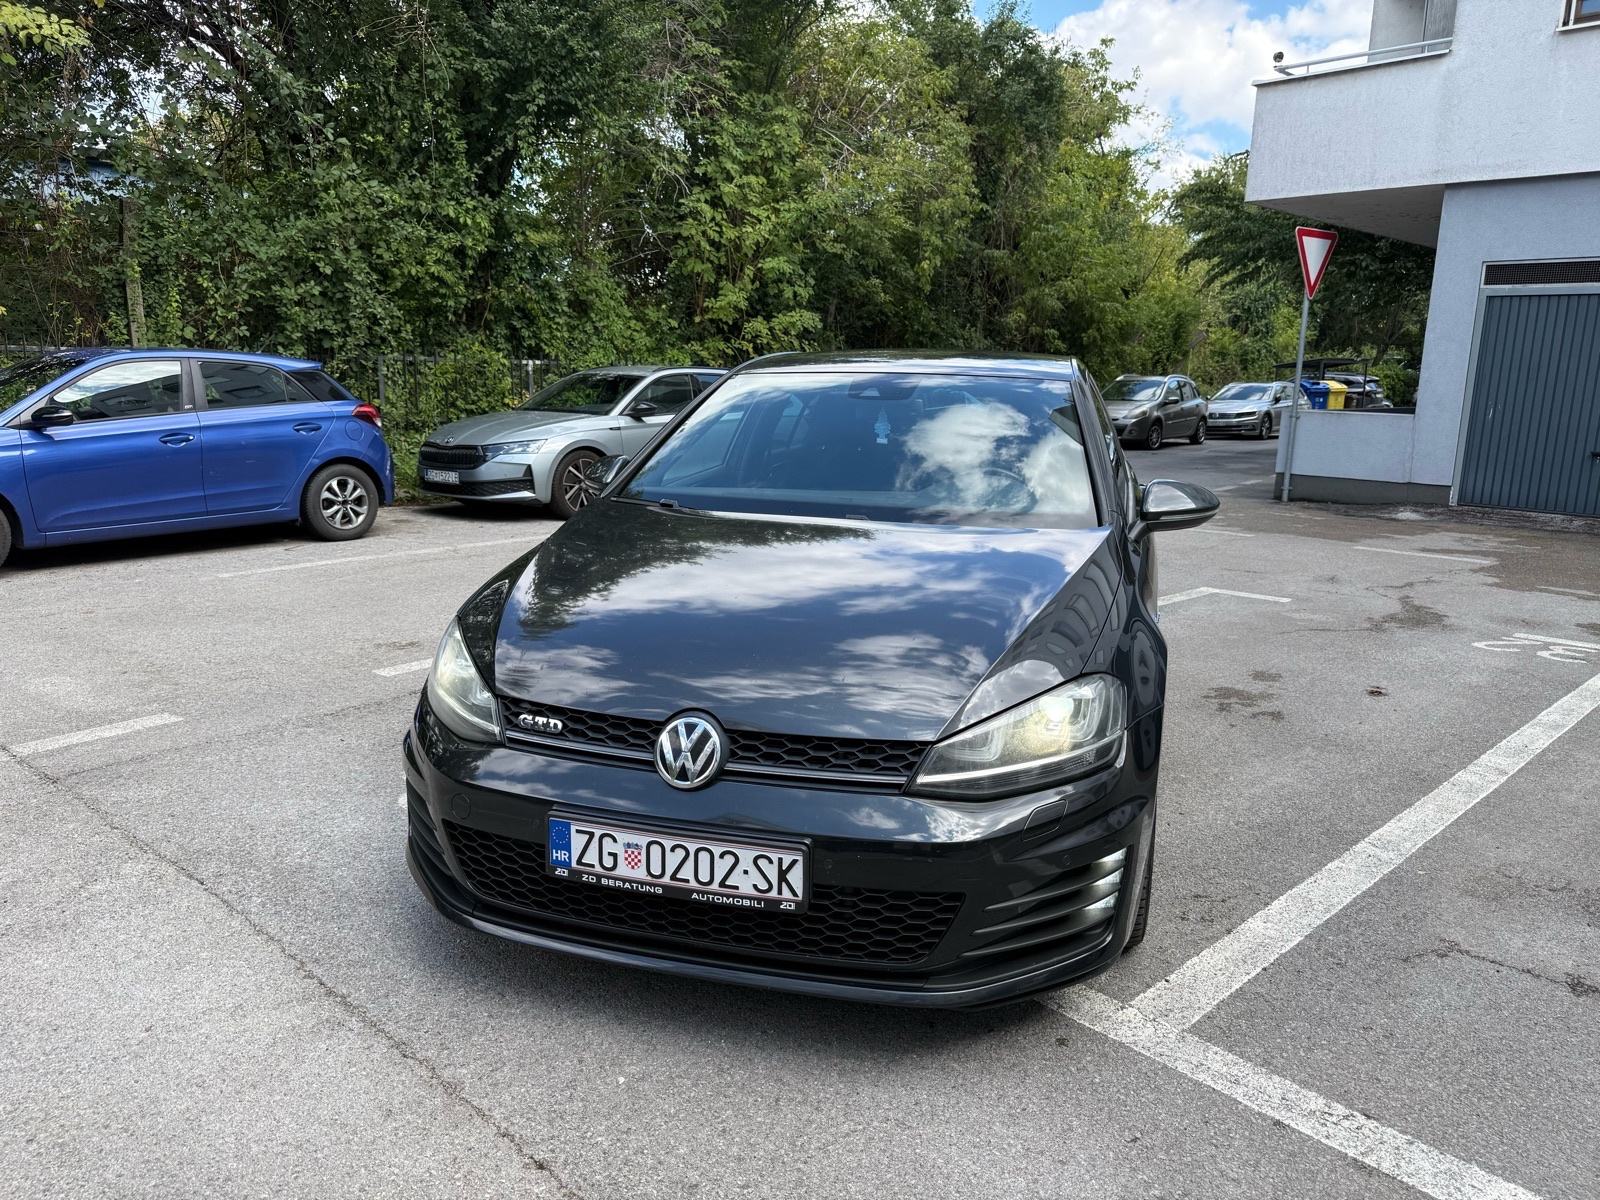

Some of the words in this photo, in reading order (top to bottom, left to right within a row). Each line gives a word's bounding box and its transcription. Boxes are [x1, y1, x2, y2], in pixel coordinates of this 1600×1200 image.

[518, 714, 563, 733] GTD
[658, 719, 719, 784] VW
[552, 849, 570, 863] HR
[575, 828, 618, 872] ZG
[601, 877, 663, 894] BERATUNG
[691, 892, 765, 908] AUTOMOBILI
